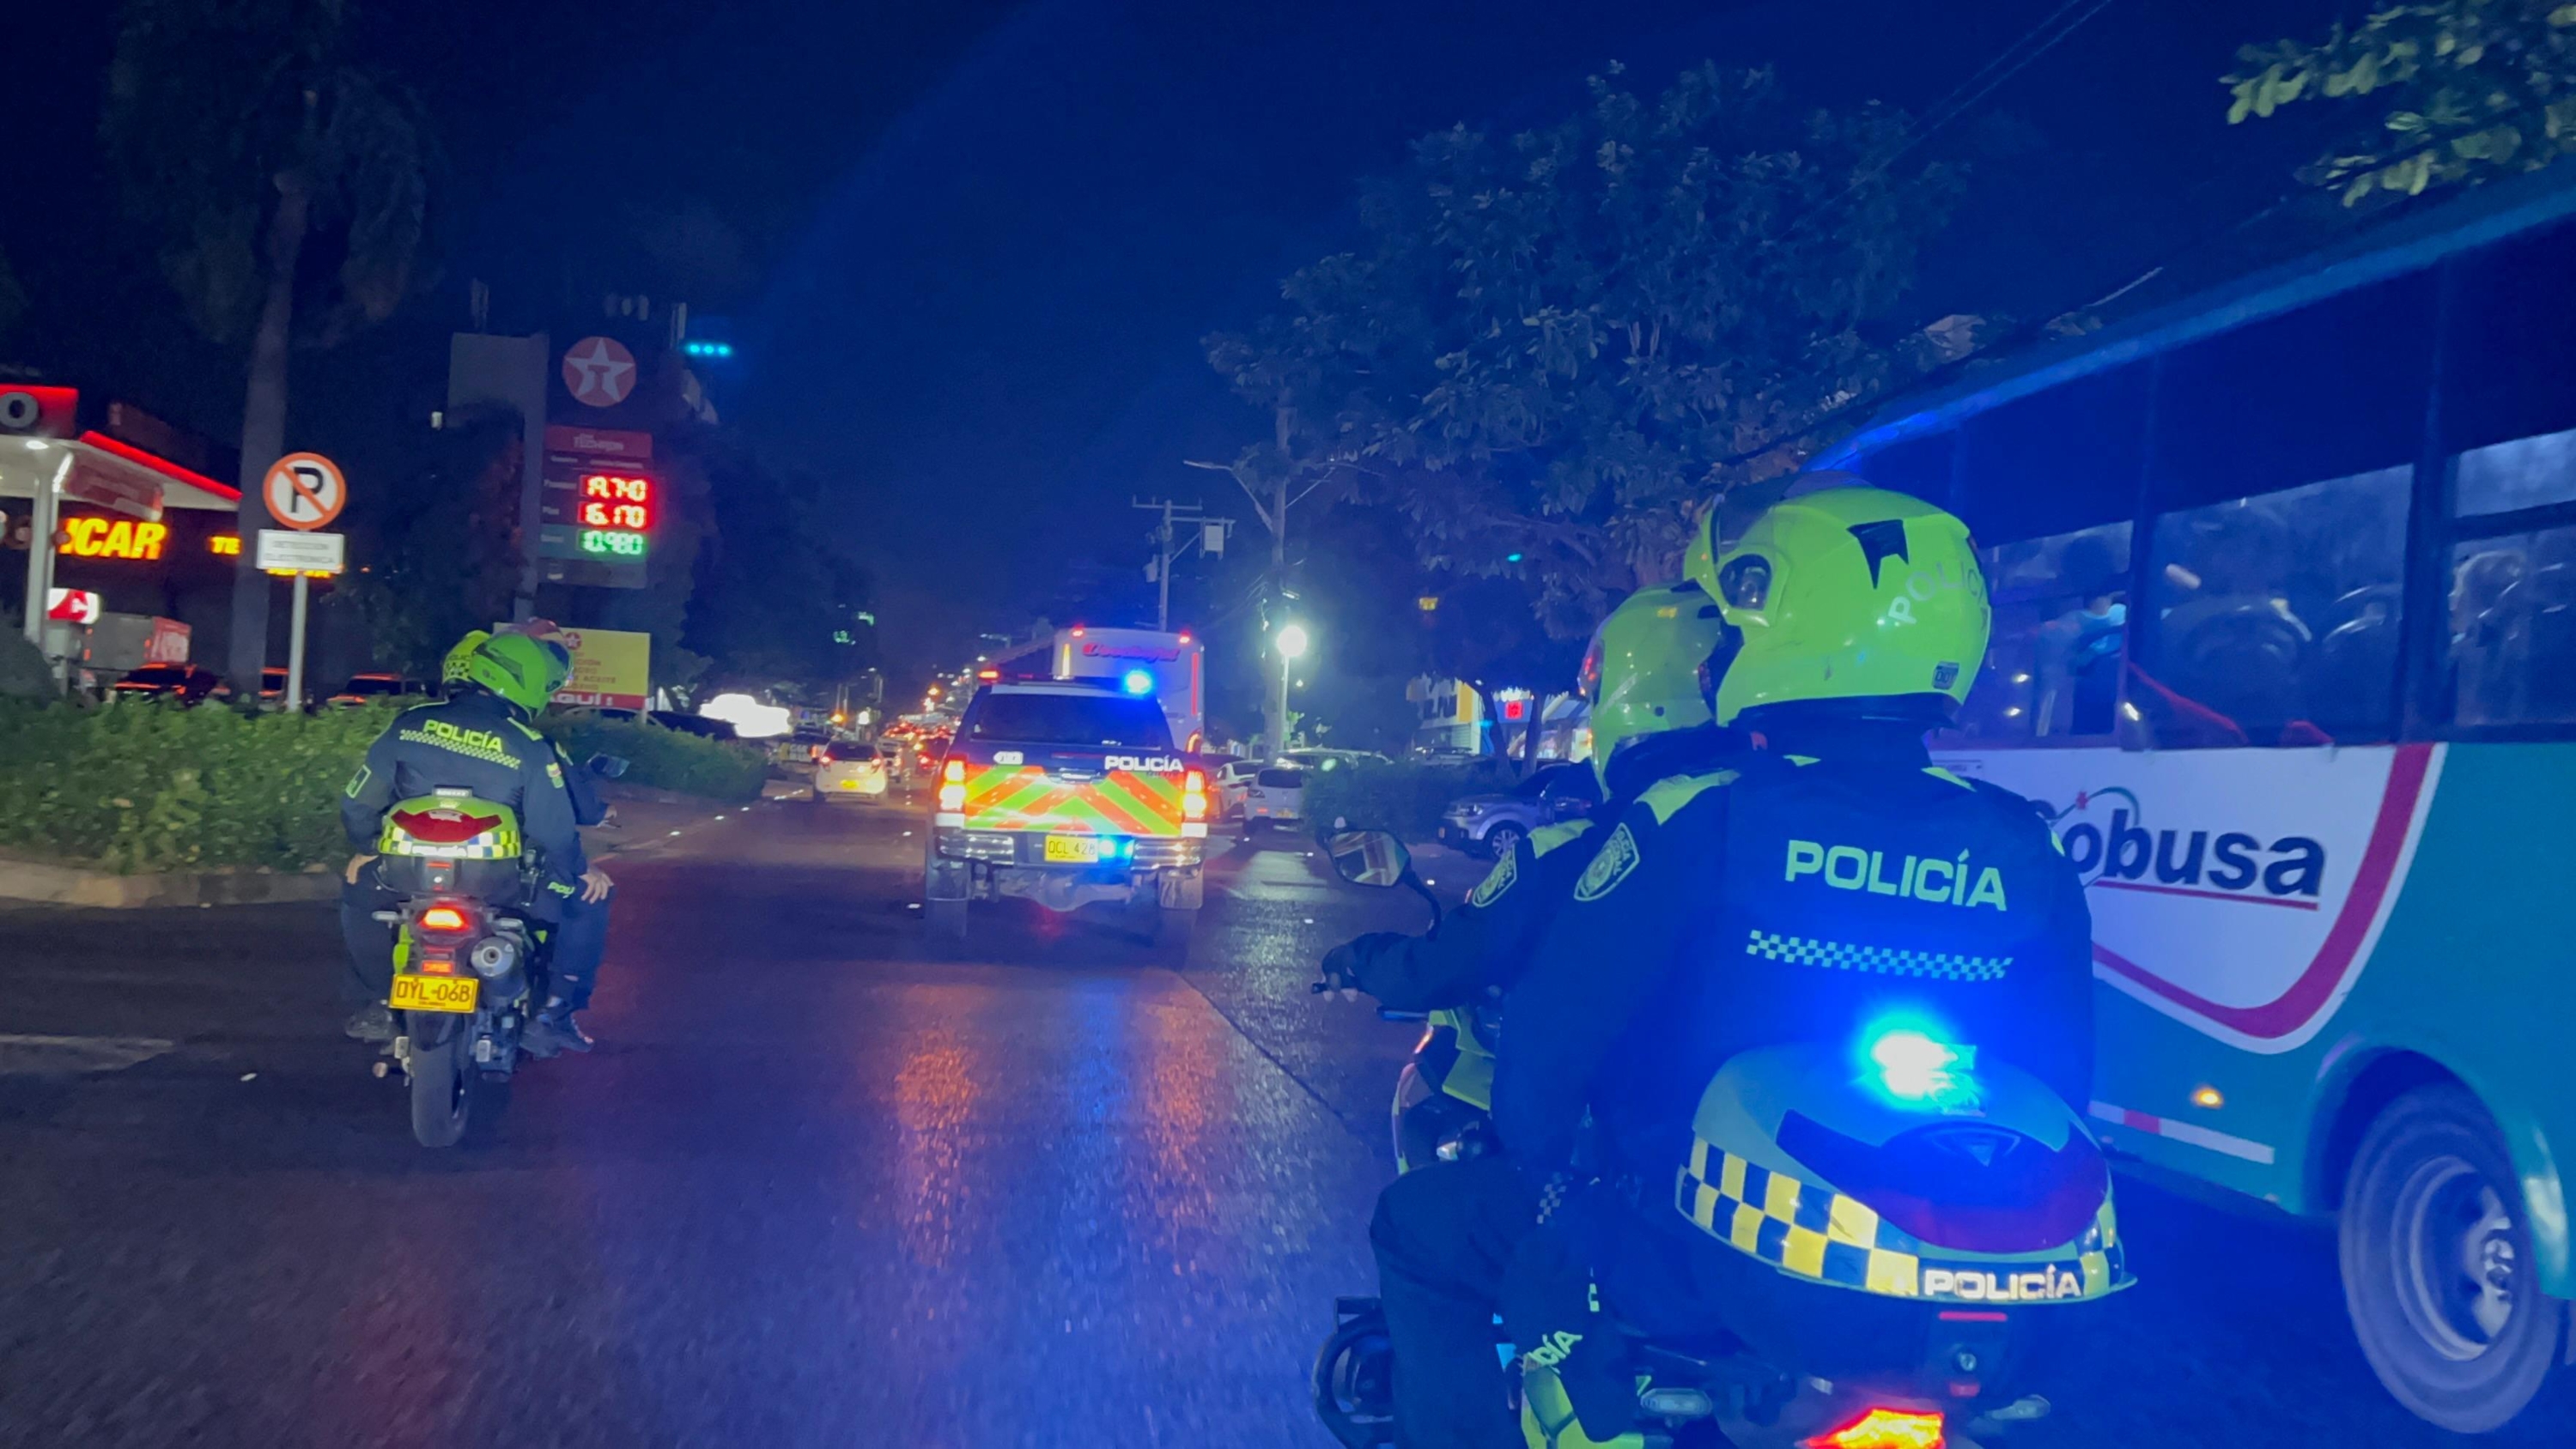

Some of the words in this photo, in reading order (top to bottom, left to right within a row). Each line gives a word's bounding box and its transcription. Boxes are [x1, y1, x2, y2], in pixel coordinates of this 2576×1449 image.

[422, 719, 502, 753] POLICÍA
[1104, 755, 1184, 772] POLICÍA
[1785, 840, 2008, 912] POLICÍA
[1923, 1263, 2082, 1300] POLICÍA
